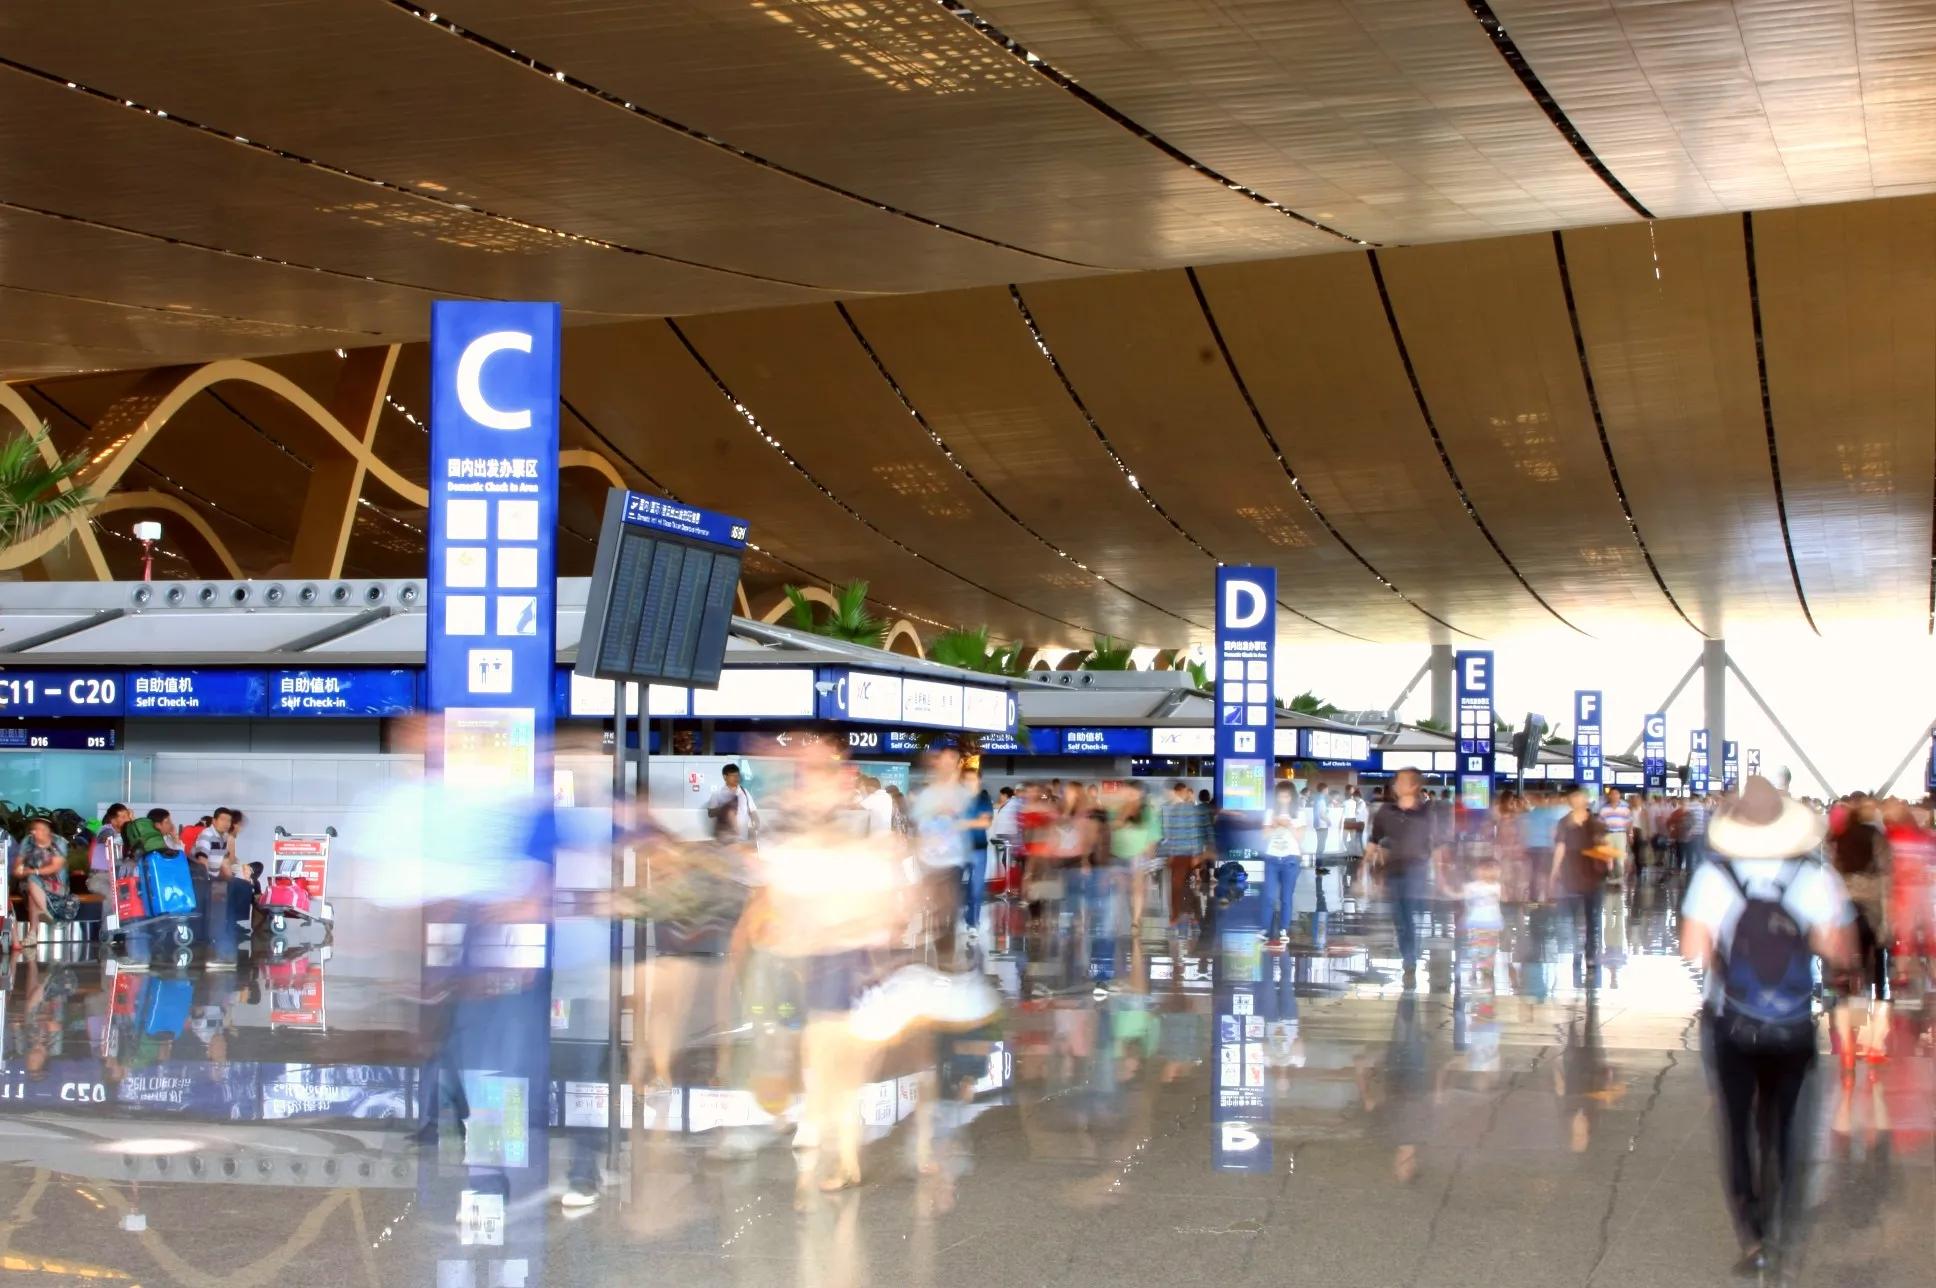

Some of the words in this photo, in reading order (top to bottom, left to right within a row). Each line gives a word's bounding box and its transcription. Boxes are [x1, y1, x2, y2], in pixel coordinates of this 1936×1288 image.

[456, 331, 532, 430] C
[447, 458, 538, 478] 国内出发办票区
[1226, 580, 1266, 628] D
[1466, 658, 1485, 690] E
[69, 680, 116, 704] C20
[136, 677, 193, 693] 自助值机
[281, 678, 340, 693] 自助值机
[136, 696, 156, 707] Self
[157, 696, 199, 707] Check-in
[281, 696, 301, 708] Self
[303, 697, 346, 708] Check-in
[1581, 696, 1596, 720] F
[1008, 699, 1016, 726] D
[1647, 718, 1664, 737] G
[31, 736, 49, 747] D16
[87, 737, 105, 747] D15
[849, 732, 878, 747] D20
[1067, 732, 1104, 742] 自助值机
[1692, 732, 1707, 750] H
[1067, 743, 1080, 751] Self
[1081, 743, 1108, 751] Check-in
[1727, 743, 1736, 758] J
[1748, 751, 1760, 766] K
